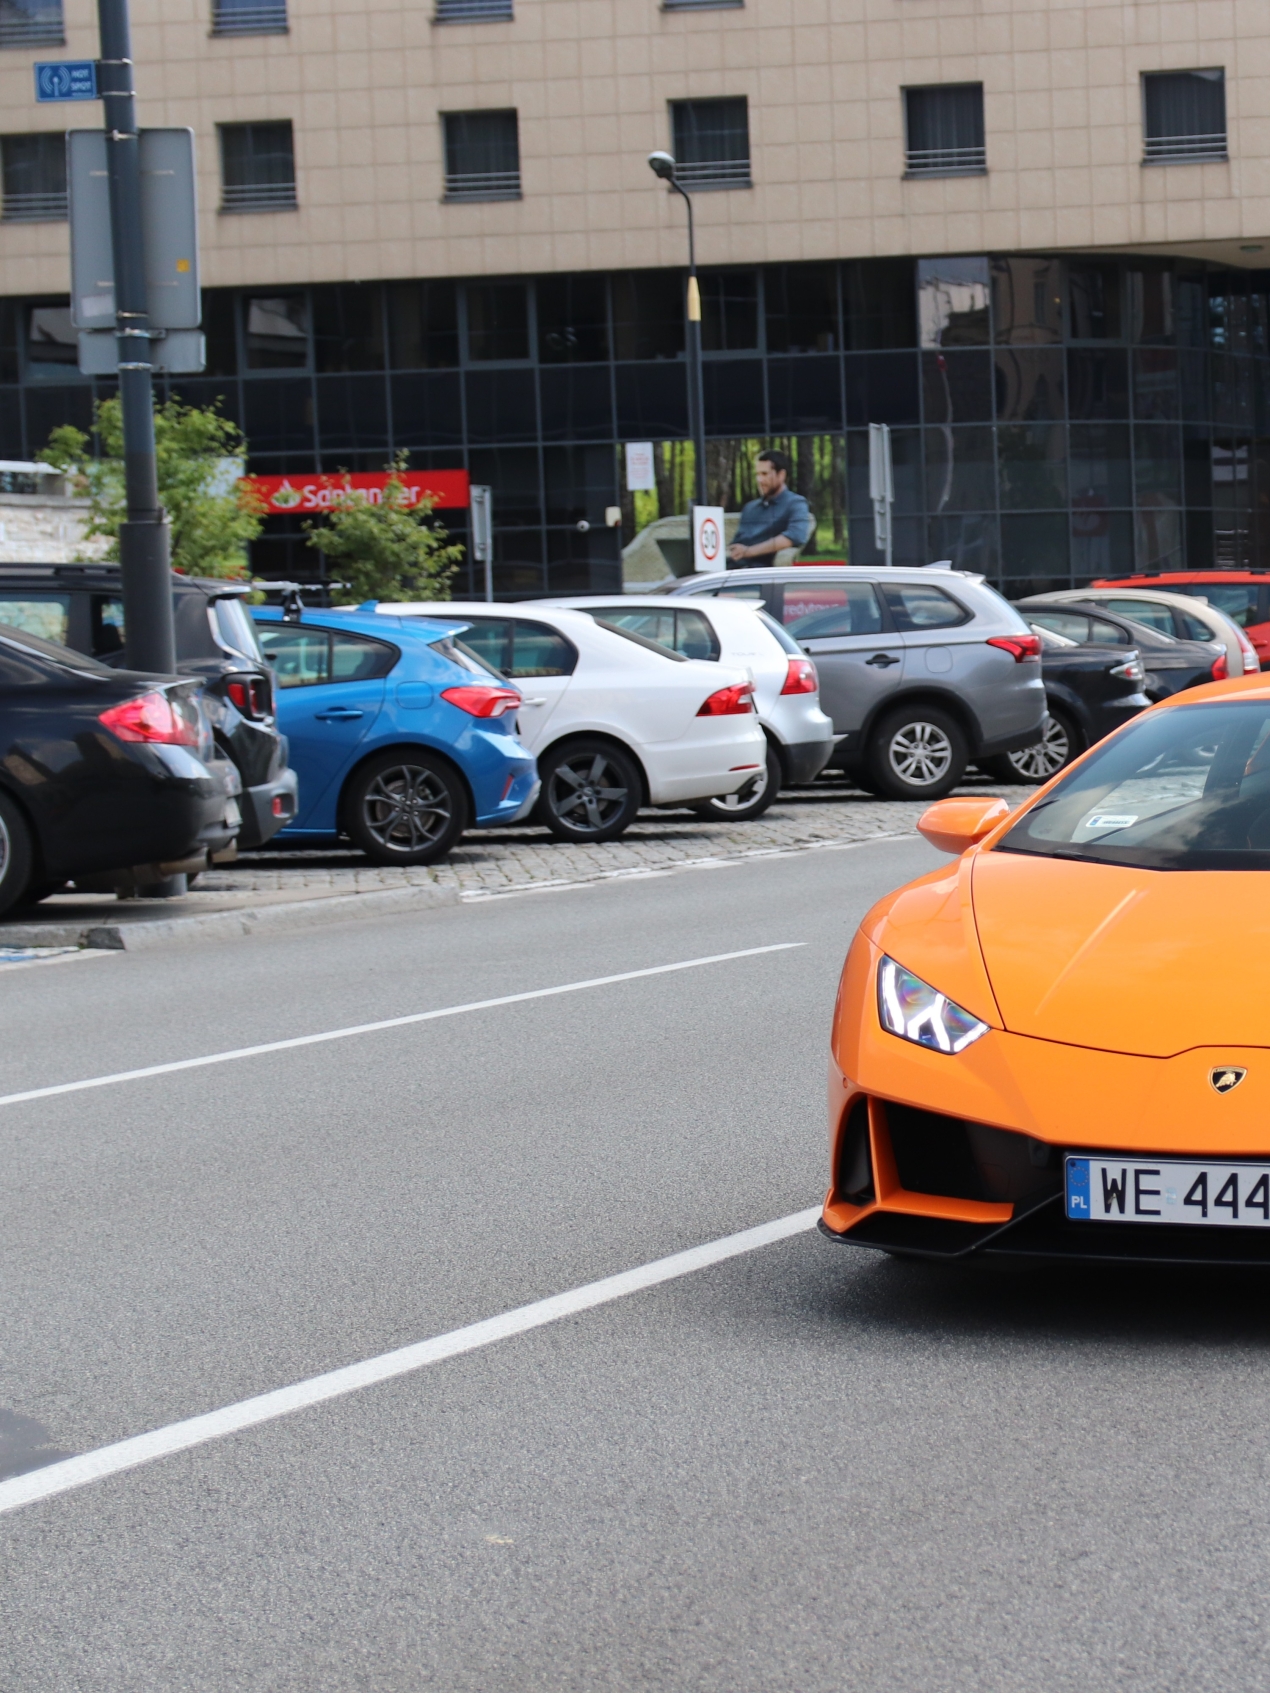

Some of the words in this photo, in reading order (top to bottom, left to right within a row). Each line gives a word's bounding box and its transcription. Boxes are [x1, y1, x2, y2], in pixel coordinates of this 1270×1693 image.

[703, 529, 717, 549] 30
[1071, 1196, 1087, 1209] PL
[1101, 1167, 1161, 1215] WE
